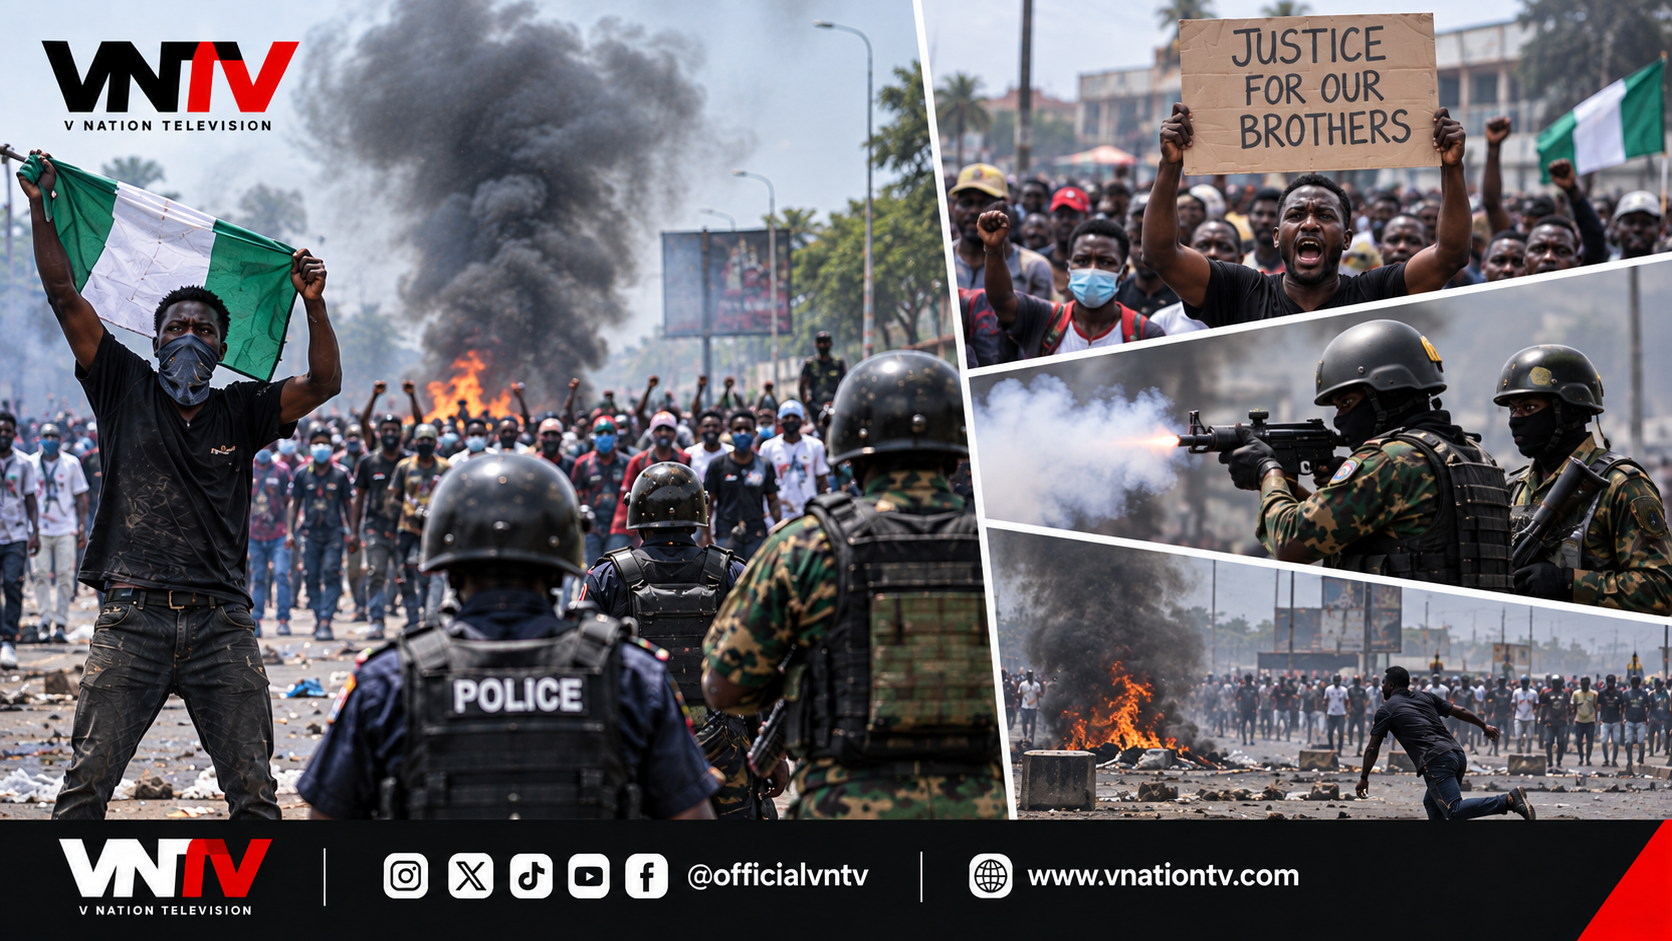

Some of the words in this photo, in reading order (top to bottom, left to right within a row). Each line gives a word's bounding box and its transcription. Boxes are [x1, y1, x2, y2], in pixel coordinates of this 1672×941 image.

[1232, 25, 1387, 68] JUSTICE
[1245, 73, 1307, 106] FOR
[1320, 69, 1385, 104] OUR
[1240, 108, 1412, 150] BROTHERS
[453, 677, 583, 714] POLICE
